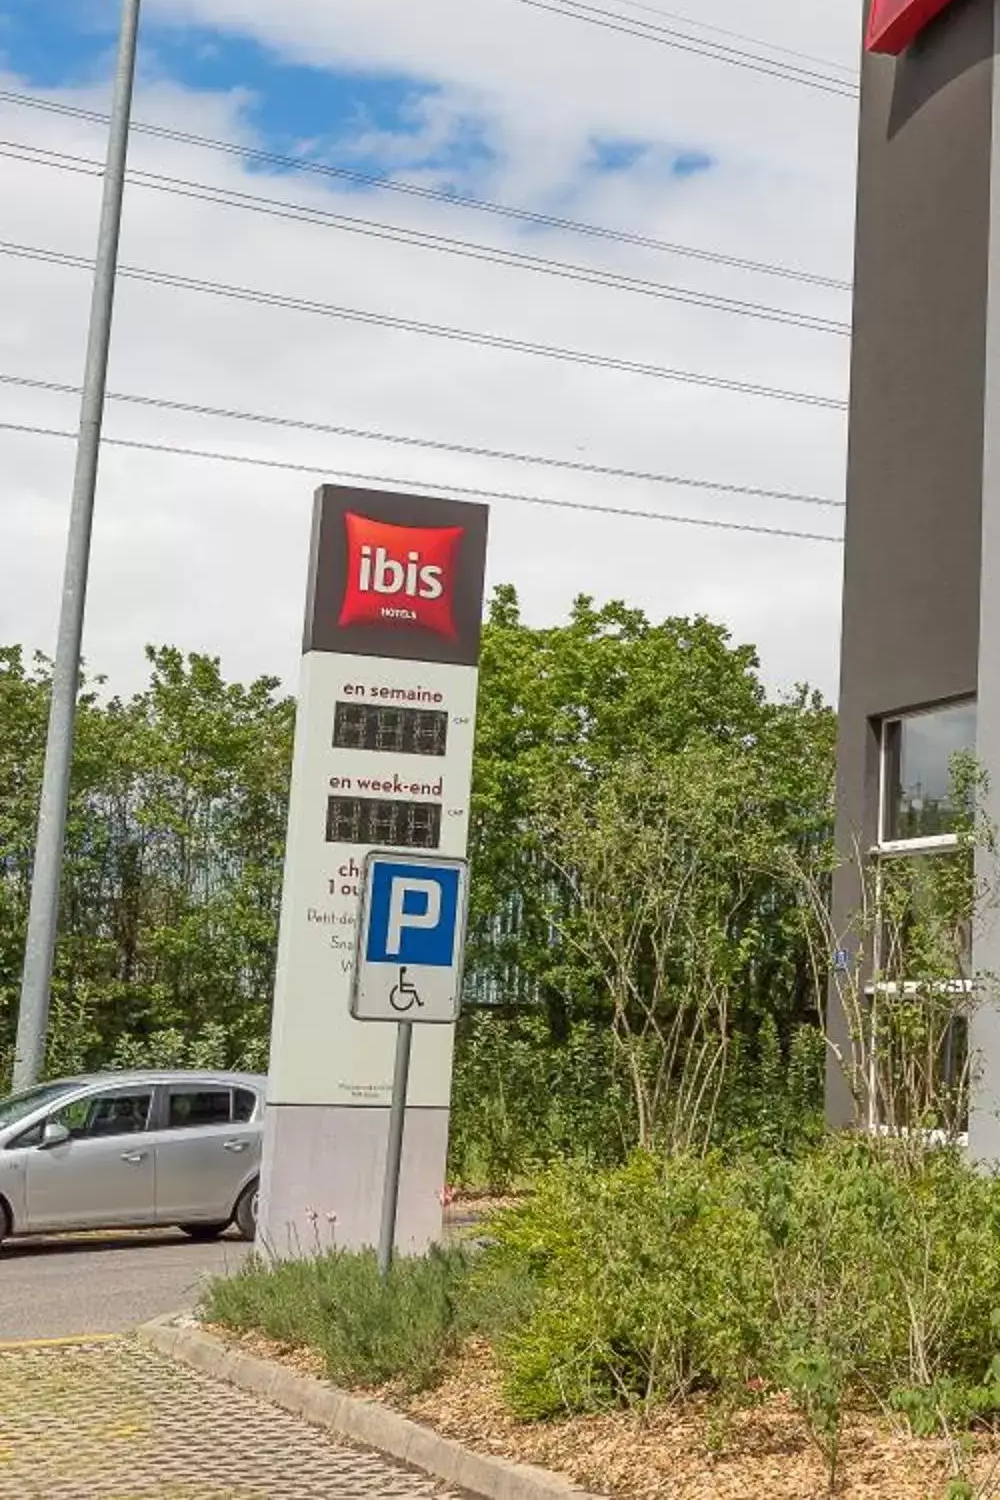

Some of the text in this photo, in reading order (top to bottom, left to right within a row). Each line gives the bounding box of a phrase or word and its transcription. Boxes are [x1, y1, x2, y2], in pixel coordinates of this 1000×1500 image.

[359, 545, 443, 599] ibis
[381, 607, 417, 620] HOTELS
[343, 683, 443, 703] en semaine
[329, 773, 443, 795] en week-end
[338, 858, 359, 877] ch
[386, 876, 442, 956] P
